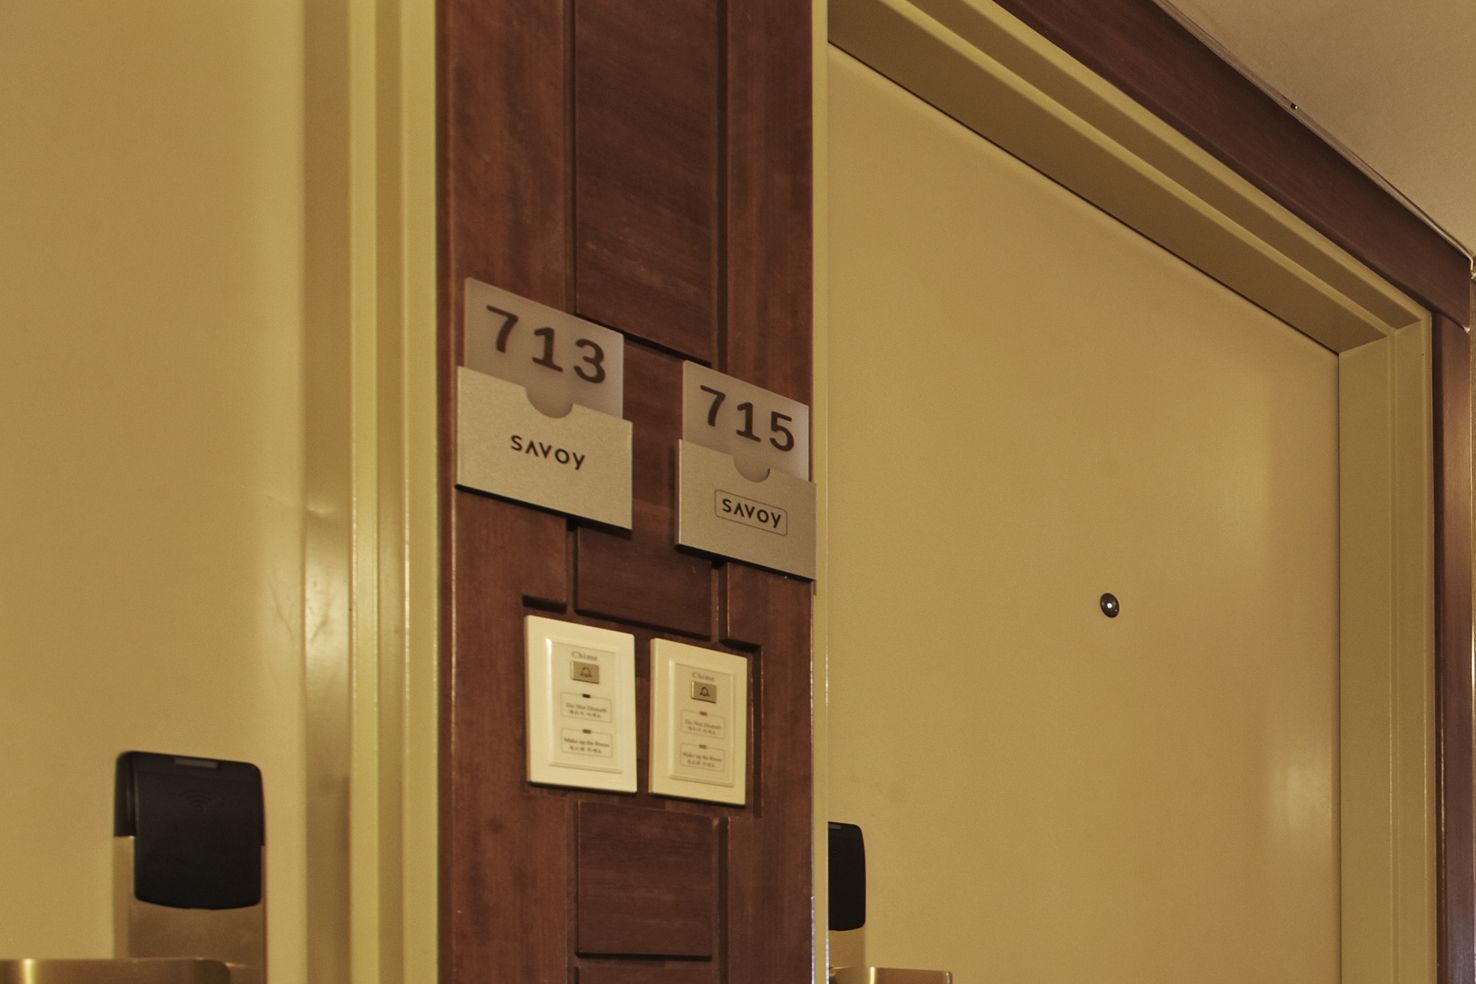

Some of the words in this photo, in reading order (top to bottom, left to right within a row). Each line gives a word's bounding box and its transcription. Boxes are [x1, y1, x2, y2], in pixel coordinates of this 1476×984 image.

[486, 305, 607, 384] 713
[699, 385, 795, 452] 715
[511, 434, 585, 470] SAVOY
[722, 498, 782, 529] SAVOY
